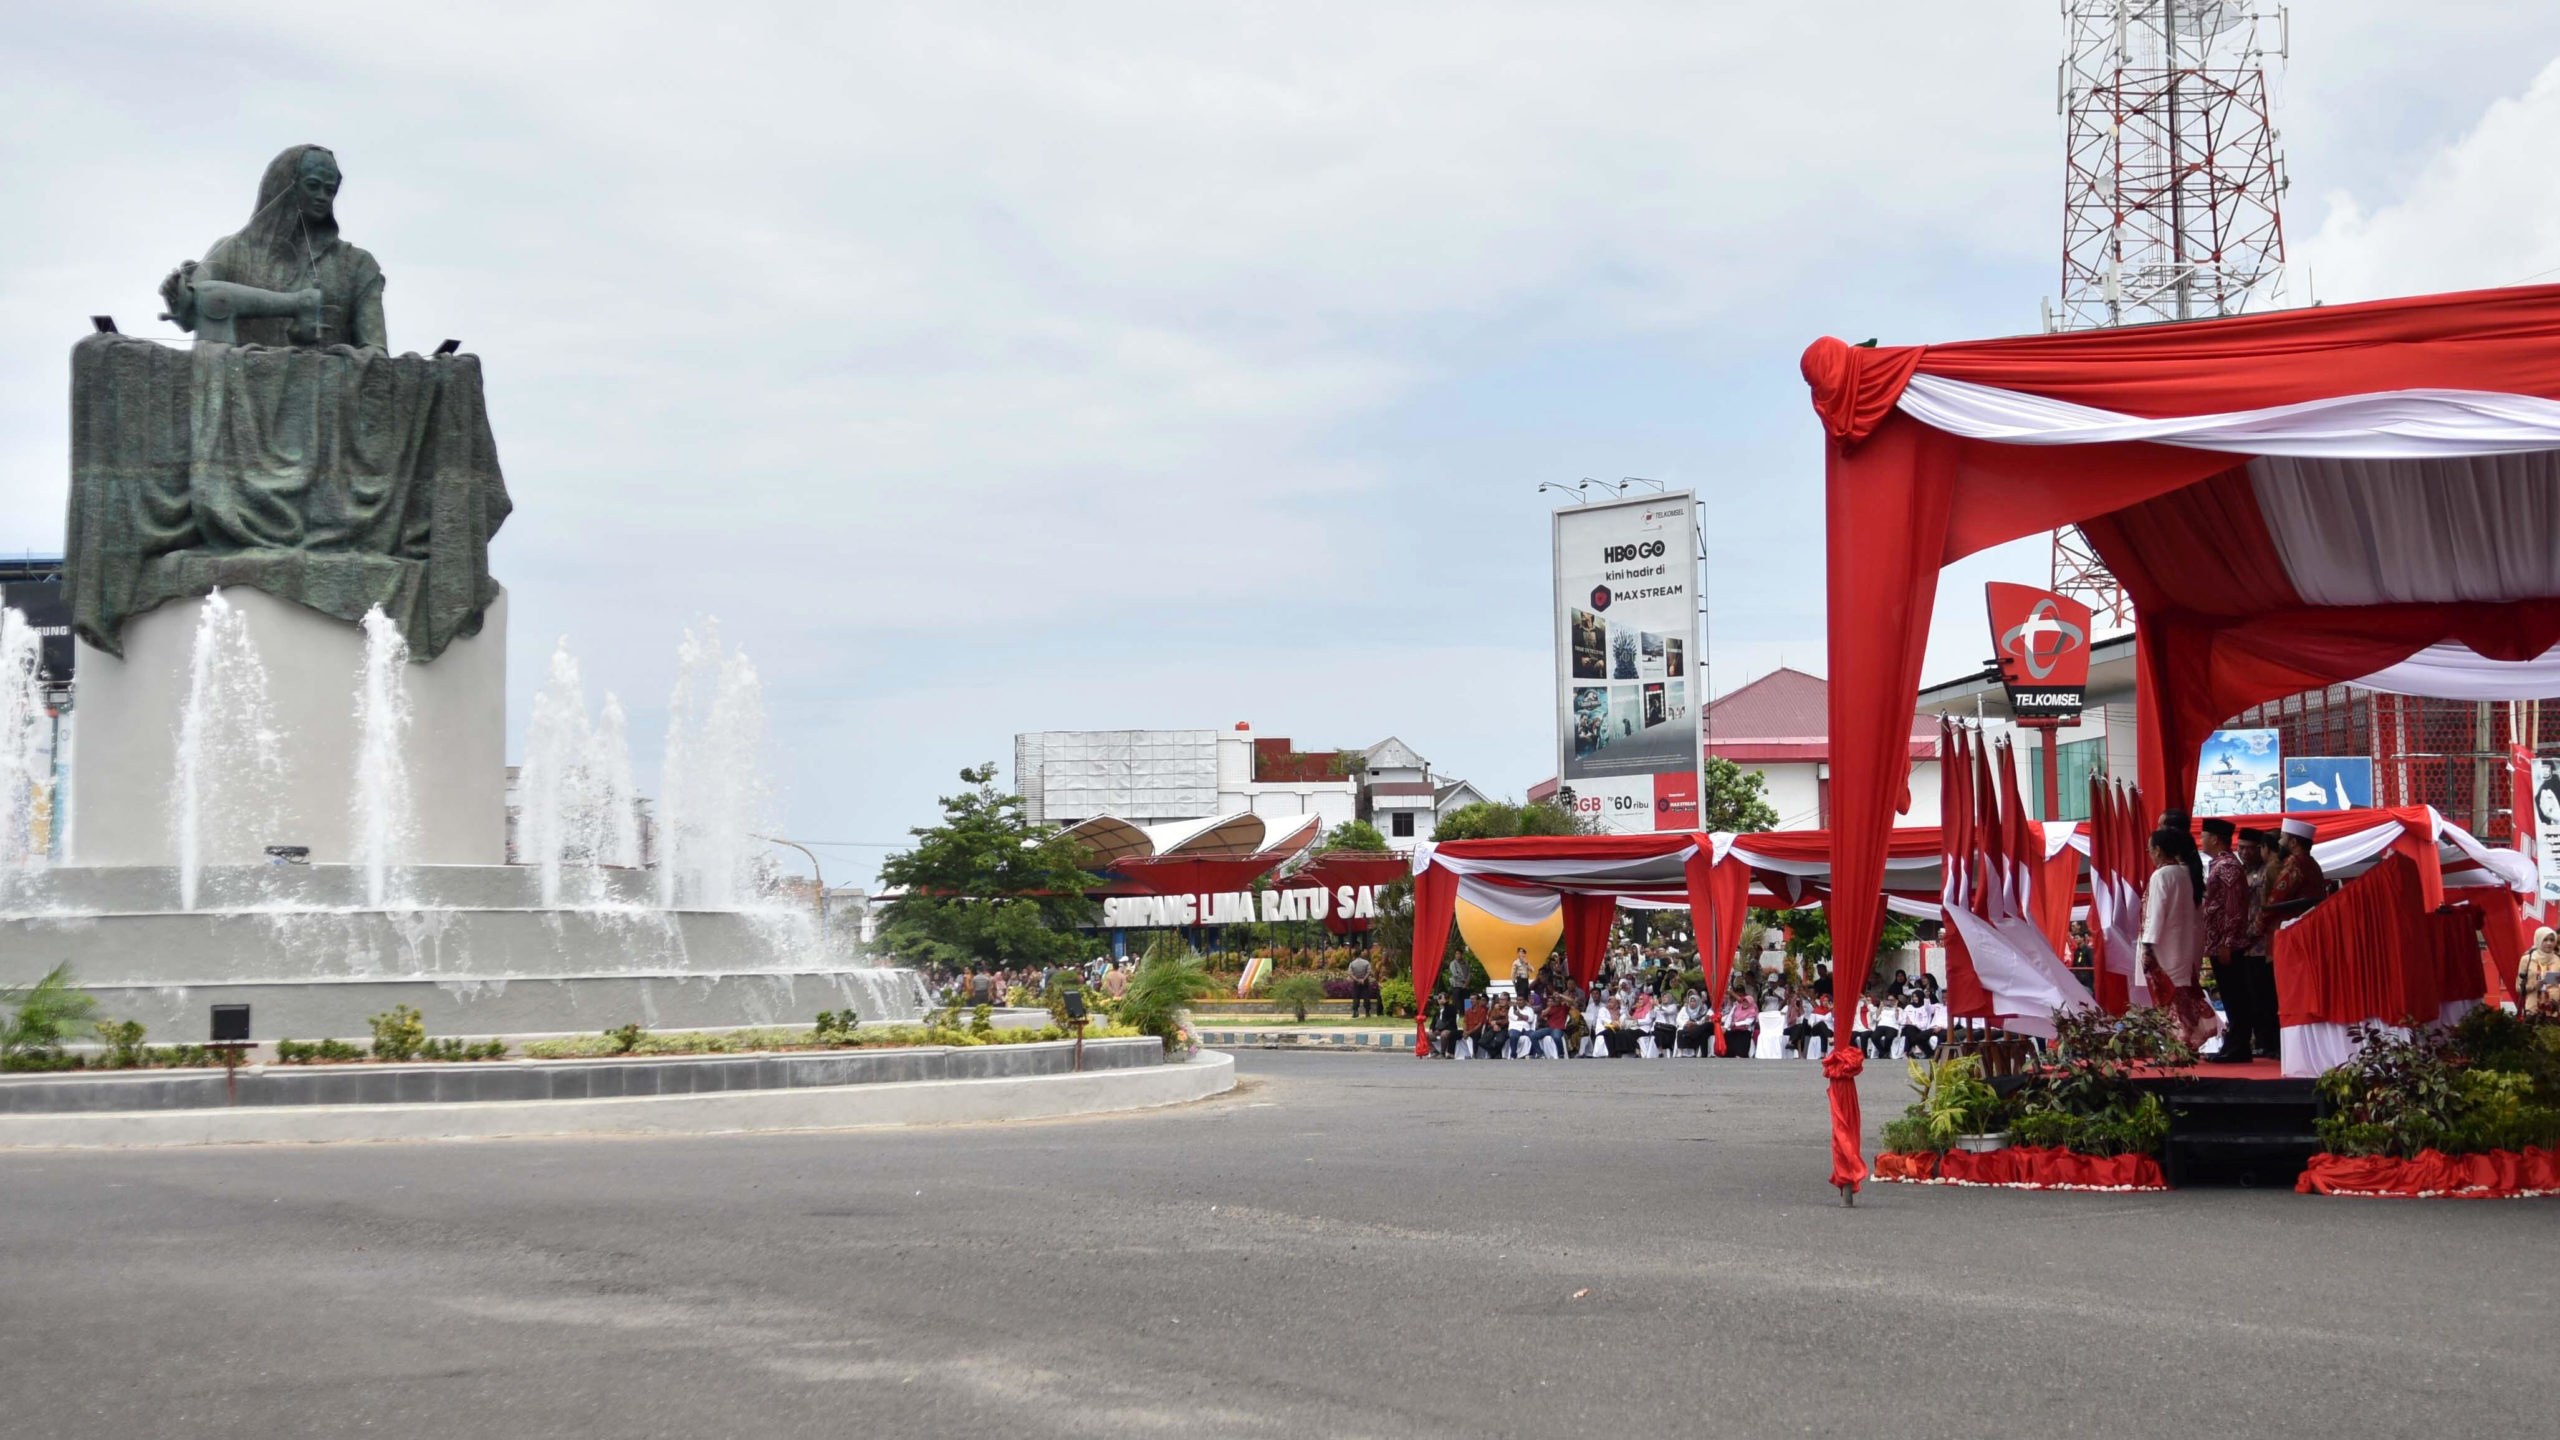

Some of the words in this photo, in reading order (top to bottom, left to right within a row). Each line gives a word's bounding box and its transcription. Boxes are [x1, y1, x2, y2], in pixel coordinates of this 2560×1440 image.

[1656, 508, 1684, 519] TELKOMSEL
[1604, 544, 1637, 563] HBO
[1638, 540, 1665, 559] GO
[1606, 570, 1624, 581] kini
[1626, 566, 1654, 579] hadir
[1656, 564, 1665, 575] di
[2015, 693, 2082, 706] TELKOMSEL
[1614, 796, 1632, 810] 60
[1633, 800, 1648, 809] ribu
[1103, 893, 1197, 927] SIMPANG
[1200, 892, 1256, 924] LIMA
[1261, 887, 1329, 922] RATU
